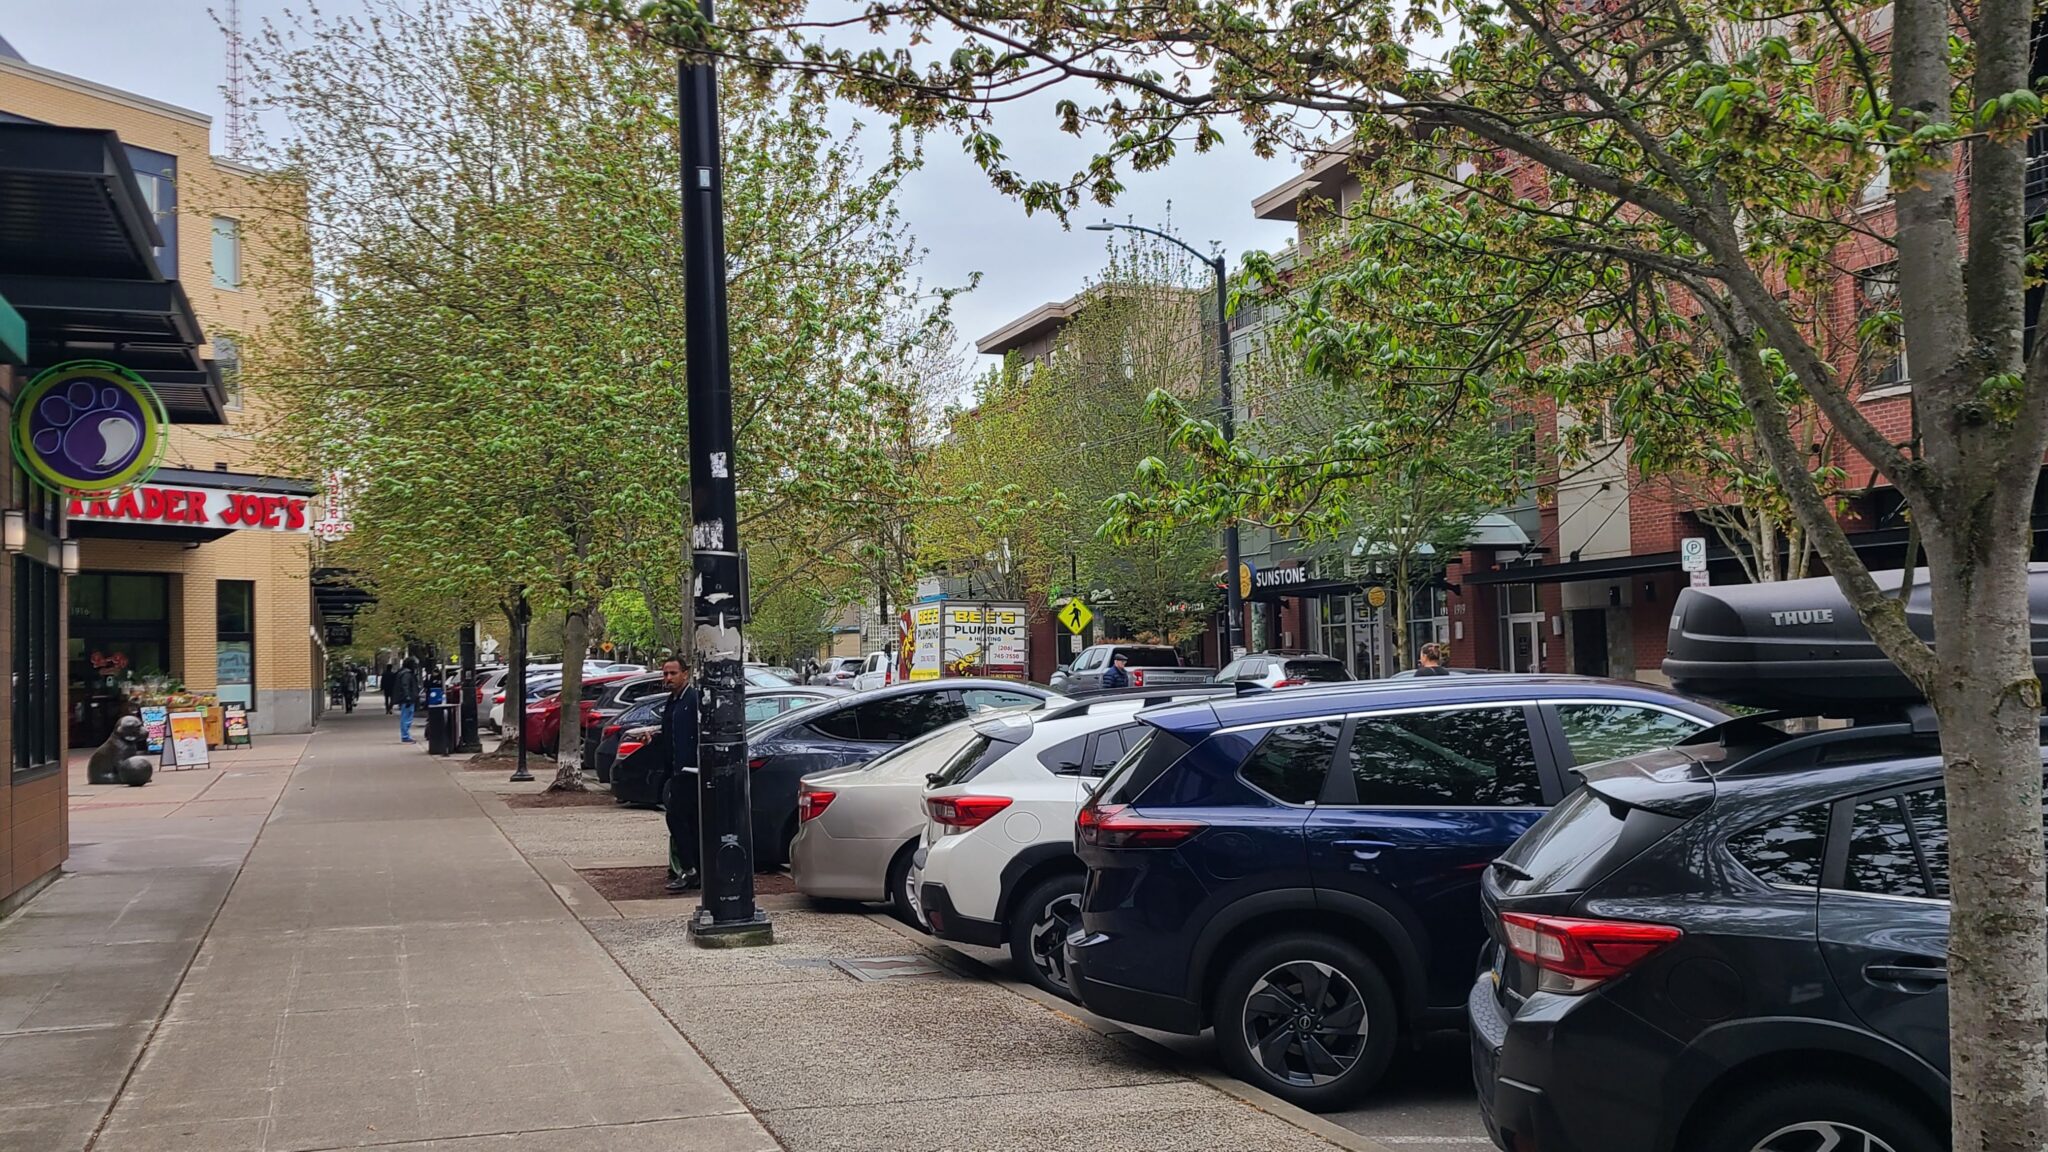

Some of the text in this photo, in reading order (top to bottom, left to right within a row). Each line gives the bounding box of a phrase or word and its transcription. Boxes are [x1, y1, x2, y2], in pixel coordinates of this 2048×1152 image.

[65, 486, 307, 529] TRADER JOE'S
[1256, 566, 1306, 588] SUNSTONE
[954, 611, 1015, 624] BEE'S
[1771, 609, 1834, 626] THULE
[954, 625, 1016, 635] PLUMBING
